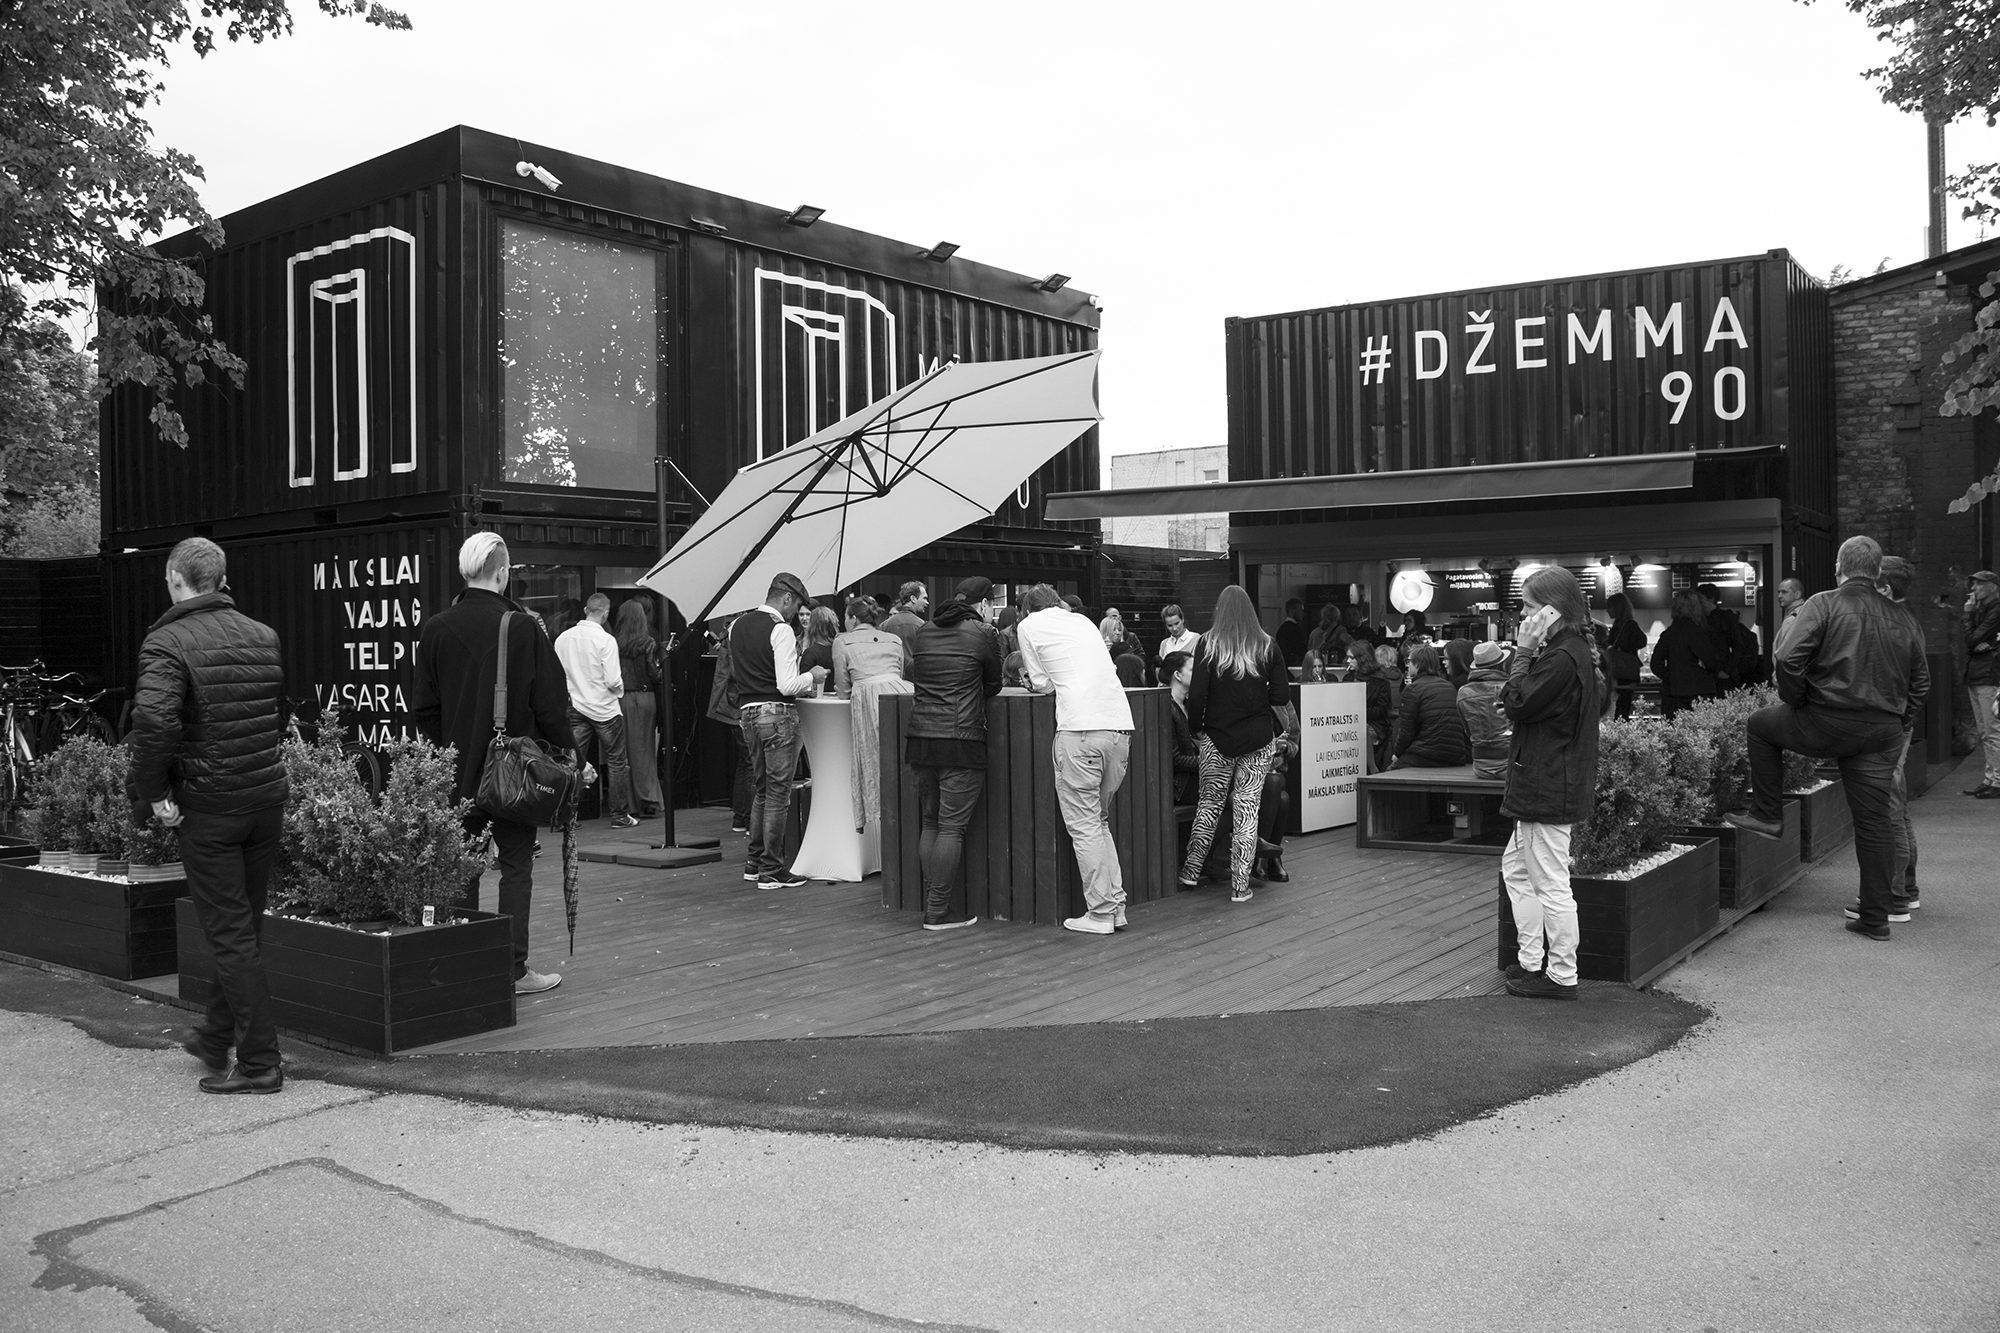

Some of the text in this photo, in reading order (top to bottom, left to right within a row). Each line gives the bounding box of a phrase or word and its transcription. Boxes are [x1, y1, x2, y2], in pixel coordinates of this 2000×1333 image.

[1661, 366, 1746, 424] 90
[314, 554, 420, 590] MĀKSLAI
[344, 598, 421, 629] VAJAG
[1309, 713, 1359, 727] TAVS ATBALSTS IR
[1315, 747, 1359, 763] LAI IEKUSTINĀTU
[1321, 763, 1359, 779] LAIKMETĪGĀS
[536, 783, 555, 794] TIMEX
[1308, 786, 1336, 799] MĀKSLAS
